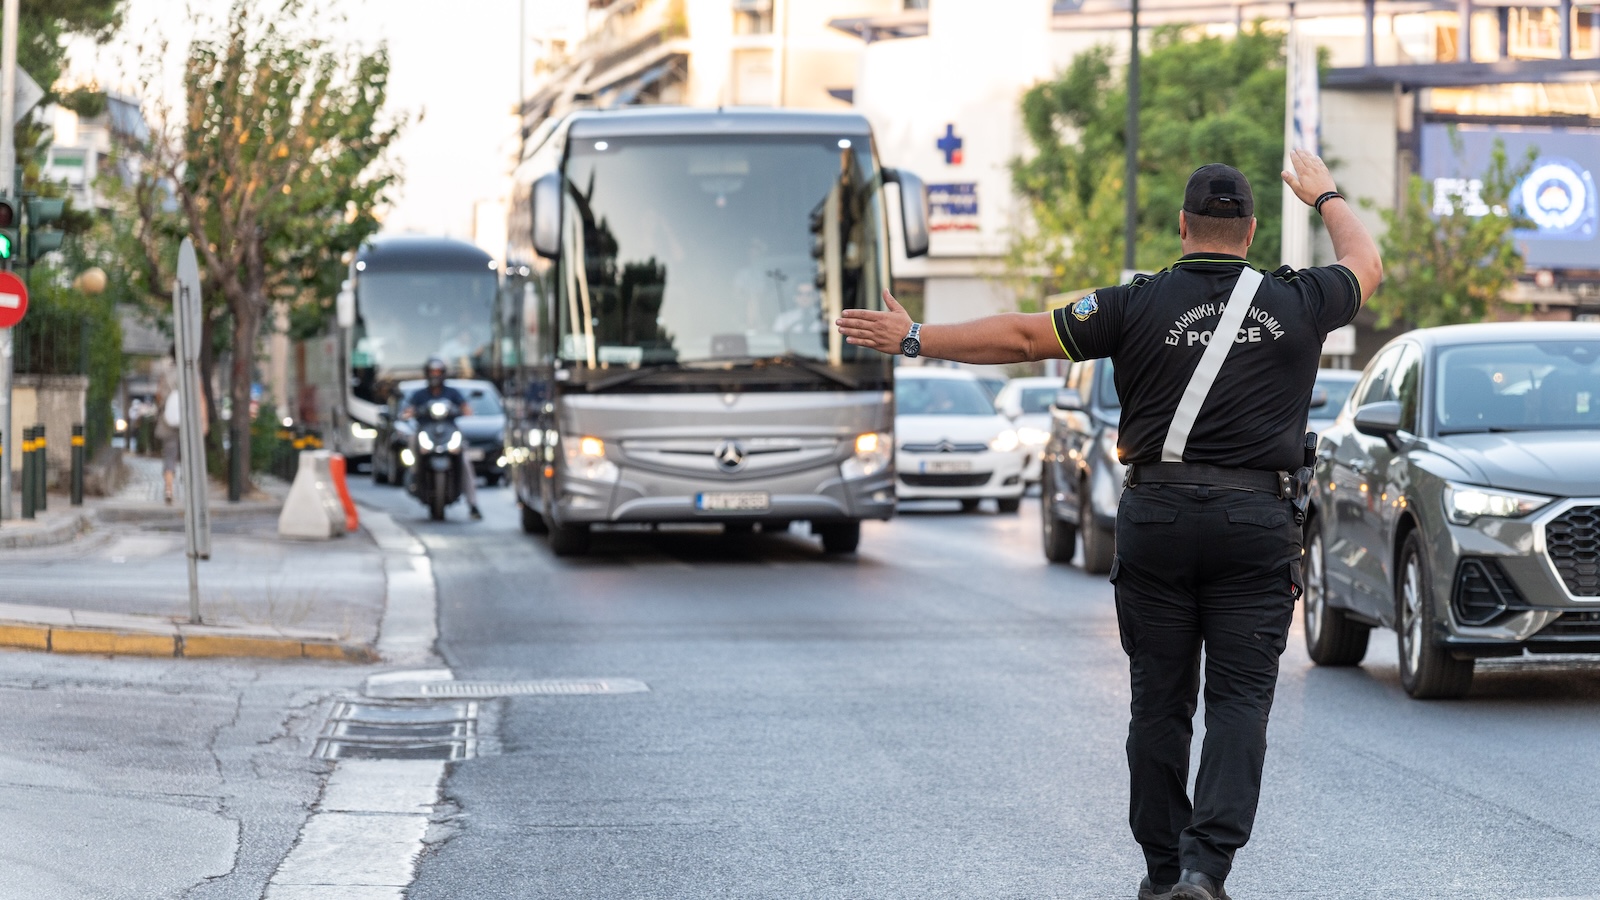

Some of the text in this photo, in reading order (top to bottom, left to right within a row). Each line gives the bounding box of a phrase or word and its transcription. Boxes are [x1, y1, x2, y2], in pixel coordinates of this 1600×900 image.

[1165, 303, 1215, 346] ΕΛΛΗΝΙΚΗ
[1218, 302, 1285, 340] ΑΝΟΜΙΑ
[1187, 327, 1261, 346] POCE
